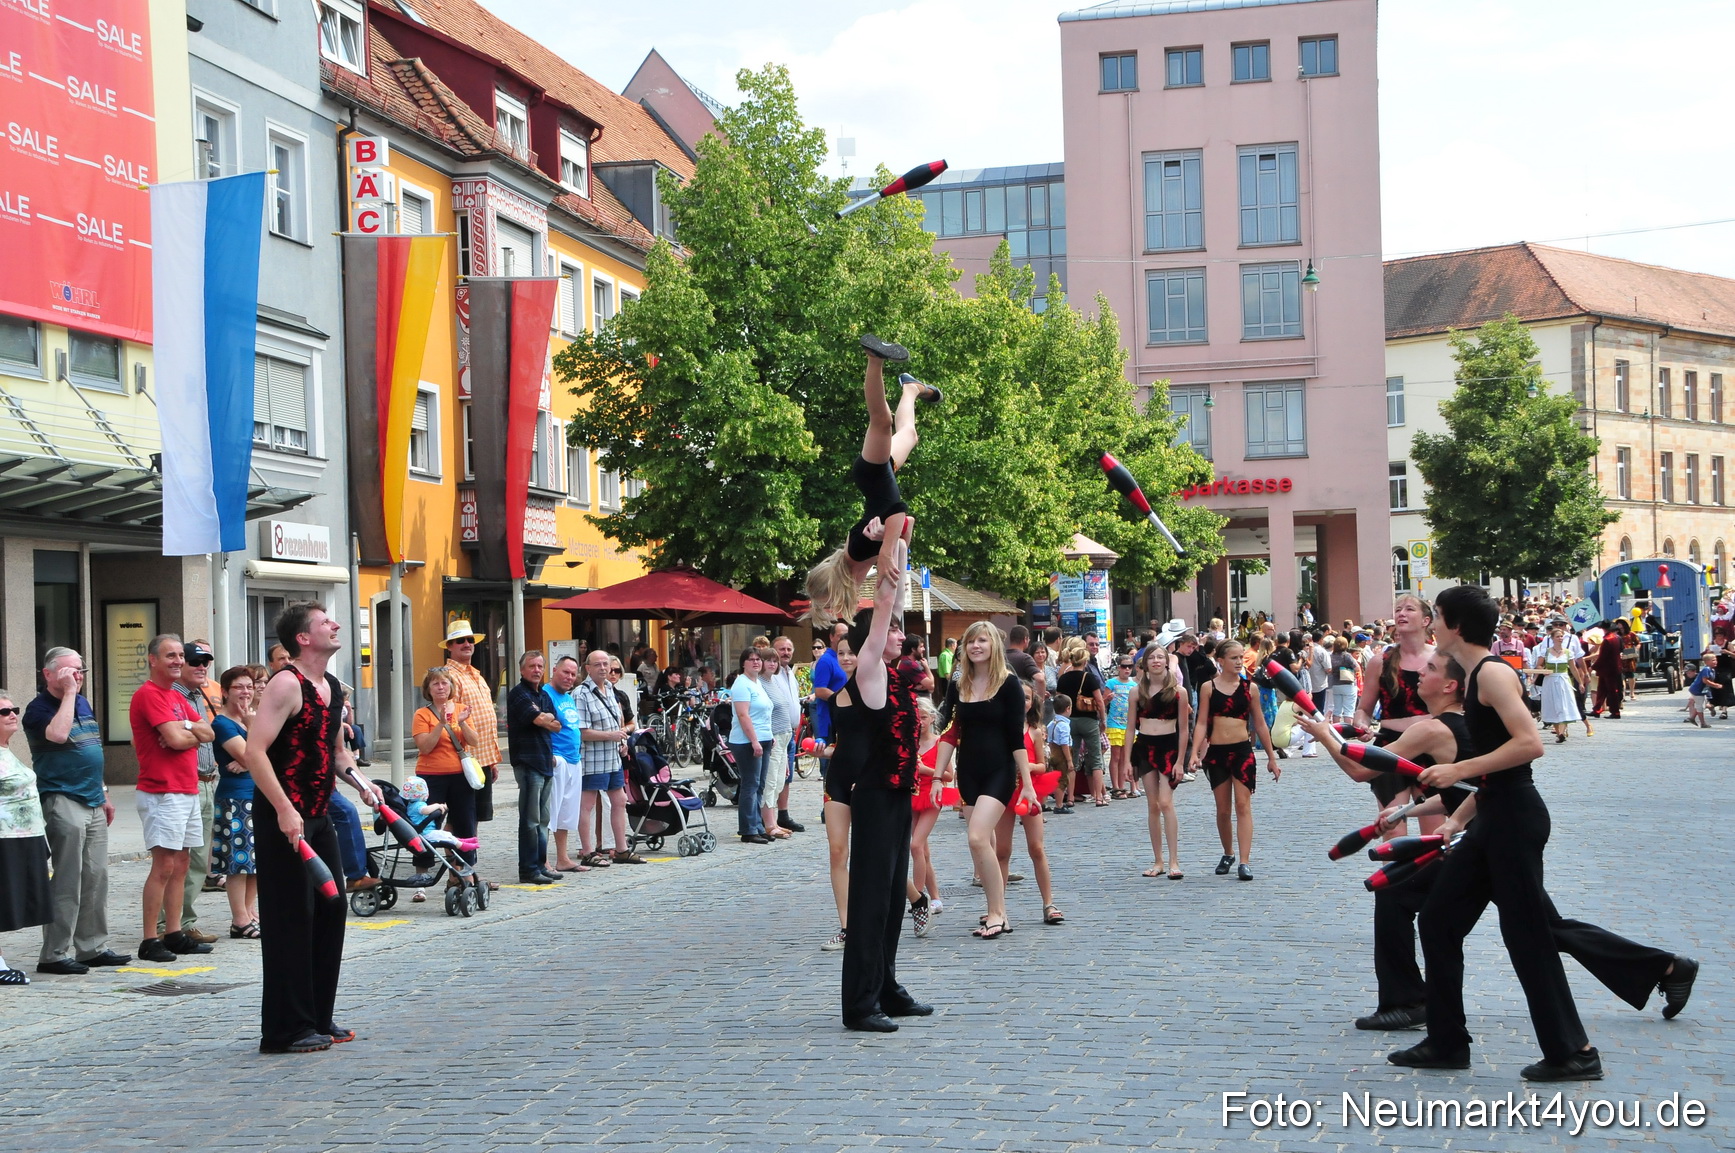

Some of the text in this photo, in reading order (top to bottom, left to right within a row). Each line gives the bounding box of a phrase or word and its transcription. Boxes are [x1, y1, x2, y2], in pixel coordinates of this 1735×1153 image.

[96, 19, 143, 56] SALE
[67, 75, 118, 111] SALE
[8, 121, 60, 159] SALE
[104, 154, 149, 187] SALE
[76, 212, 124, 245] SALE
[49, 280, 101, 309] WÖHRL
[1171, 475, 1293, 501] parkasse
[274, 523, 329, 560] Brezenhaus
